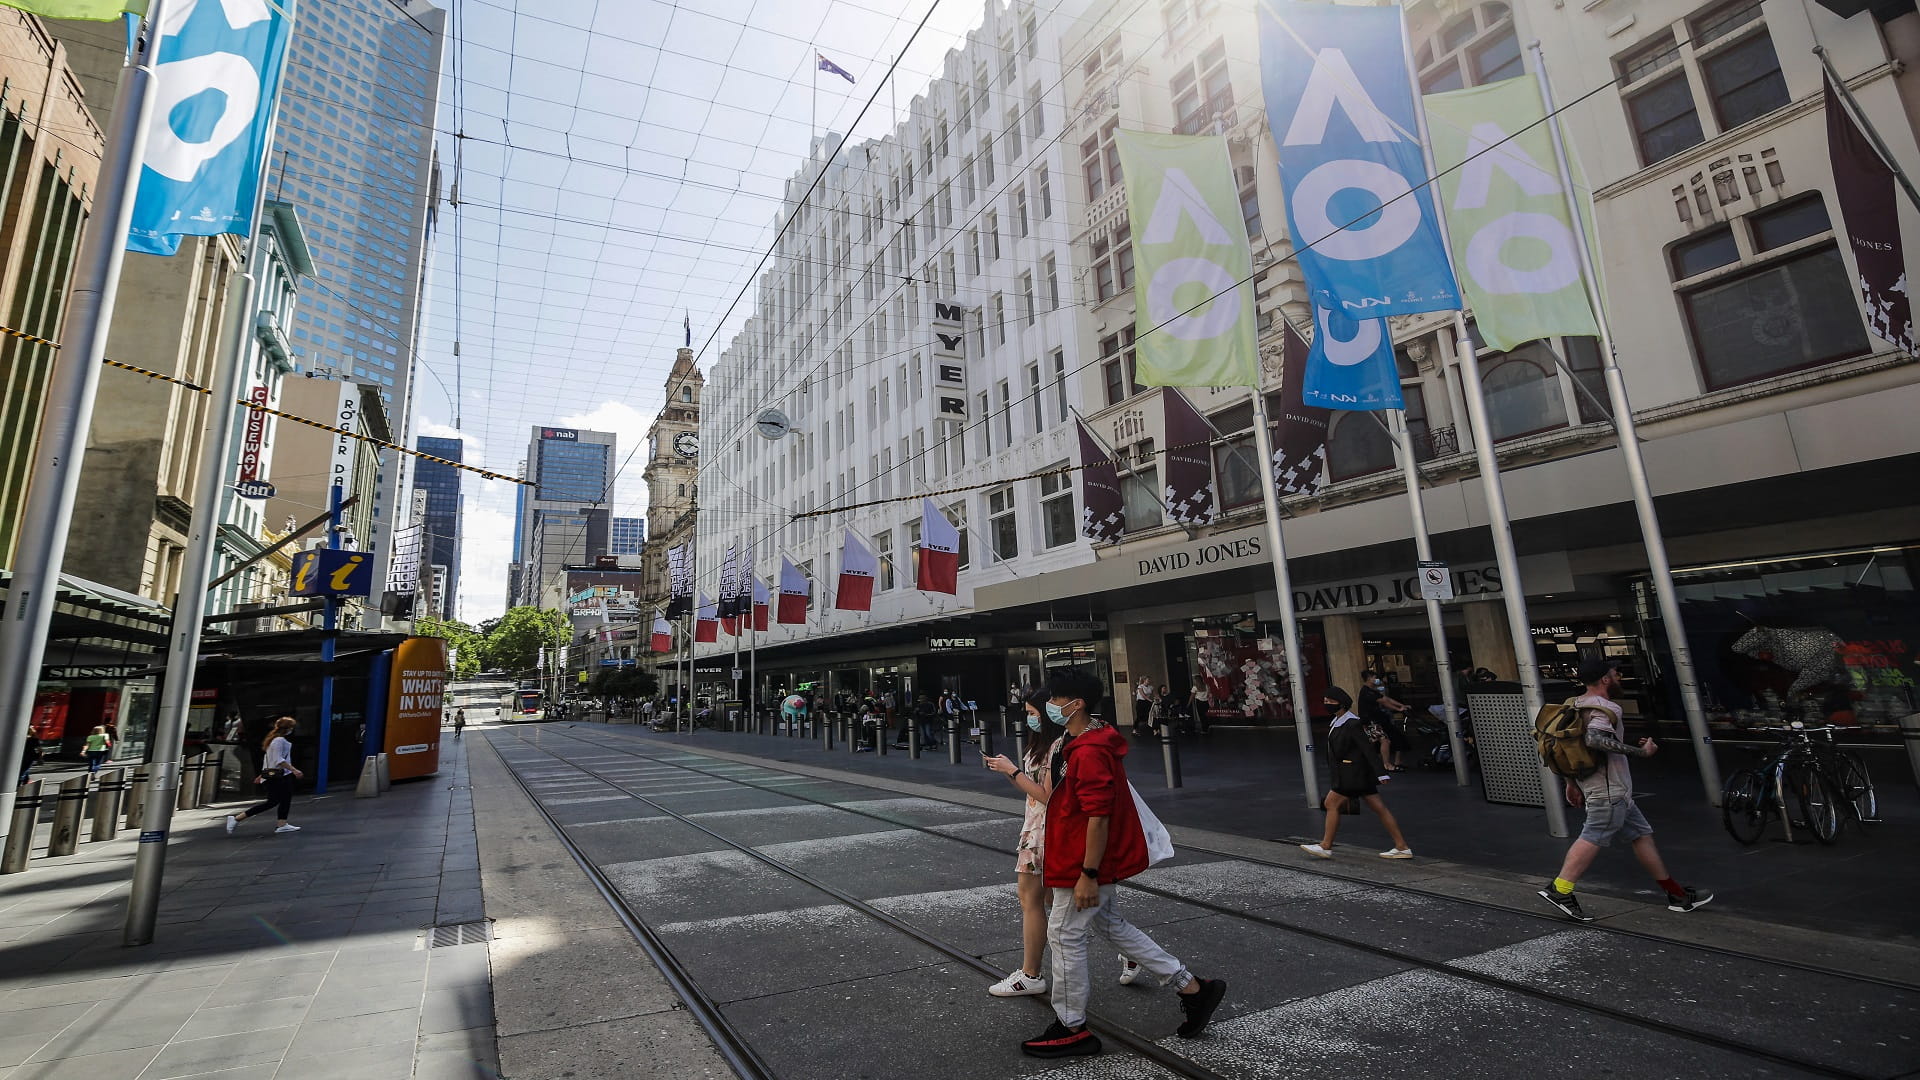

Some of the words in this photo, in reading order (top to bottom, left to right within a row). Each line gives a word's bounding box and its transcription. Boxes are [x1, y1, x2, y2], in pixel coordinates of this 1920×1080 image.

[936, 302, 965, 415] MYER
[1286, 413, 1309, 423] DAVID
[337, 399, 355, 455] ROGER
[556, 431, 575, 439] nab
[1171, 455, 1192, 463] DAVID
[1138, 552, 1190, 576] DAVID
[1196, 537, 1262, 566] JONES
[1292, 583, 1379, 612] DAVID
[1388, 566, 1503, 604] JOES
[1048, 622, 1073, 630] DAVID
[1530, 625, 1573, 636] CHANEL
[930, 638, 976, 647] MYER
[399, 695, 414, 710] IN
